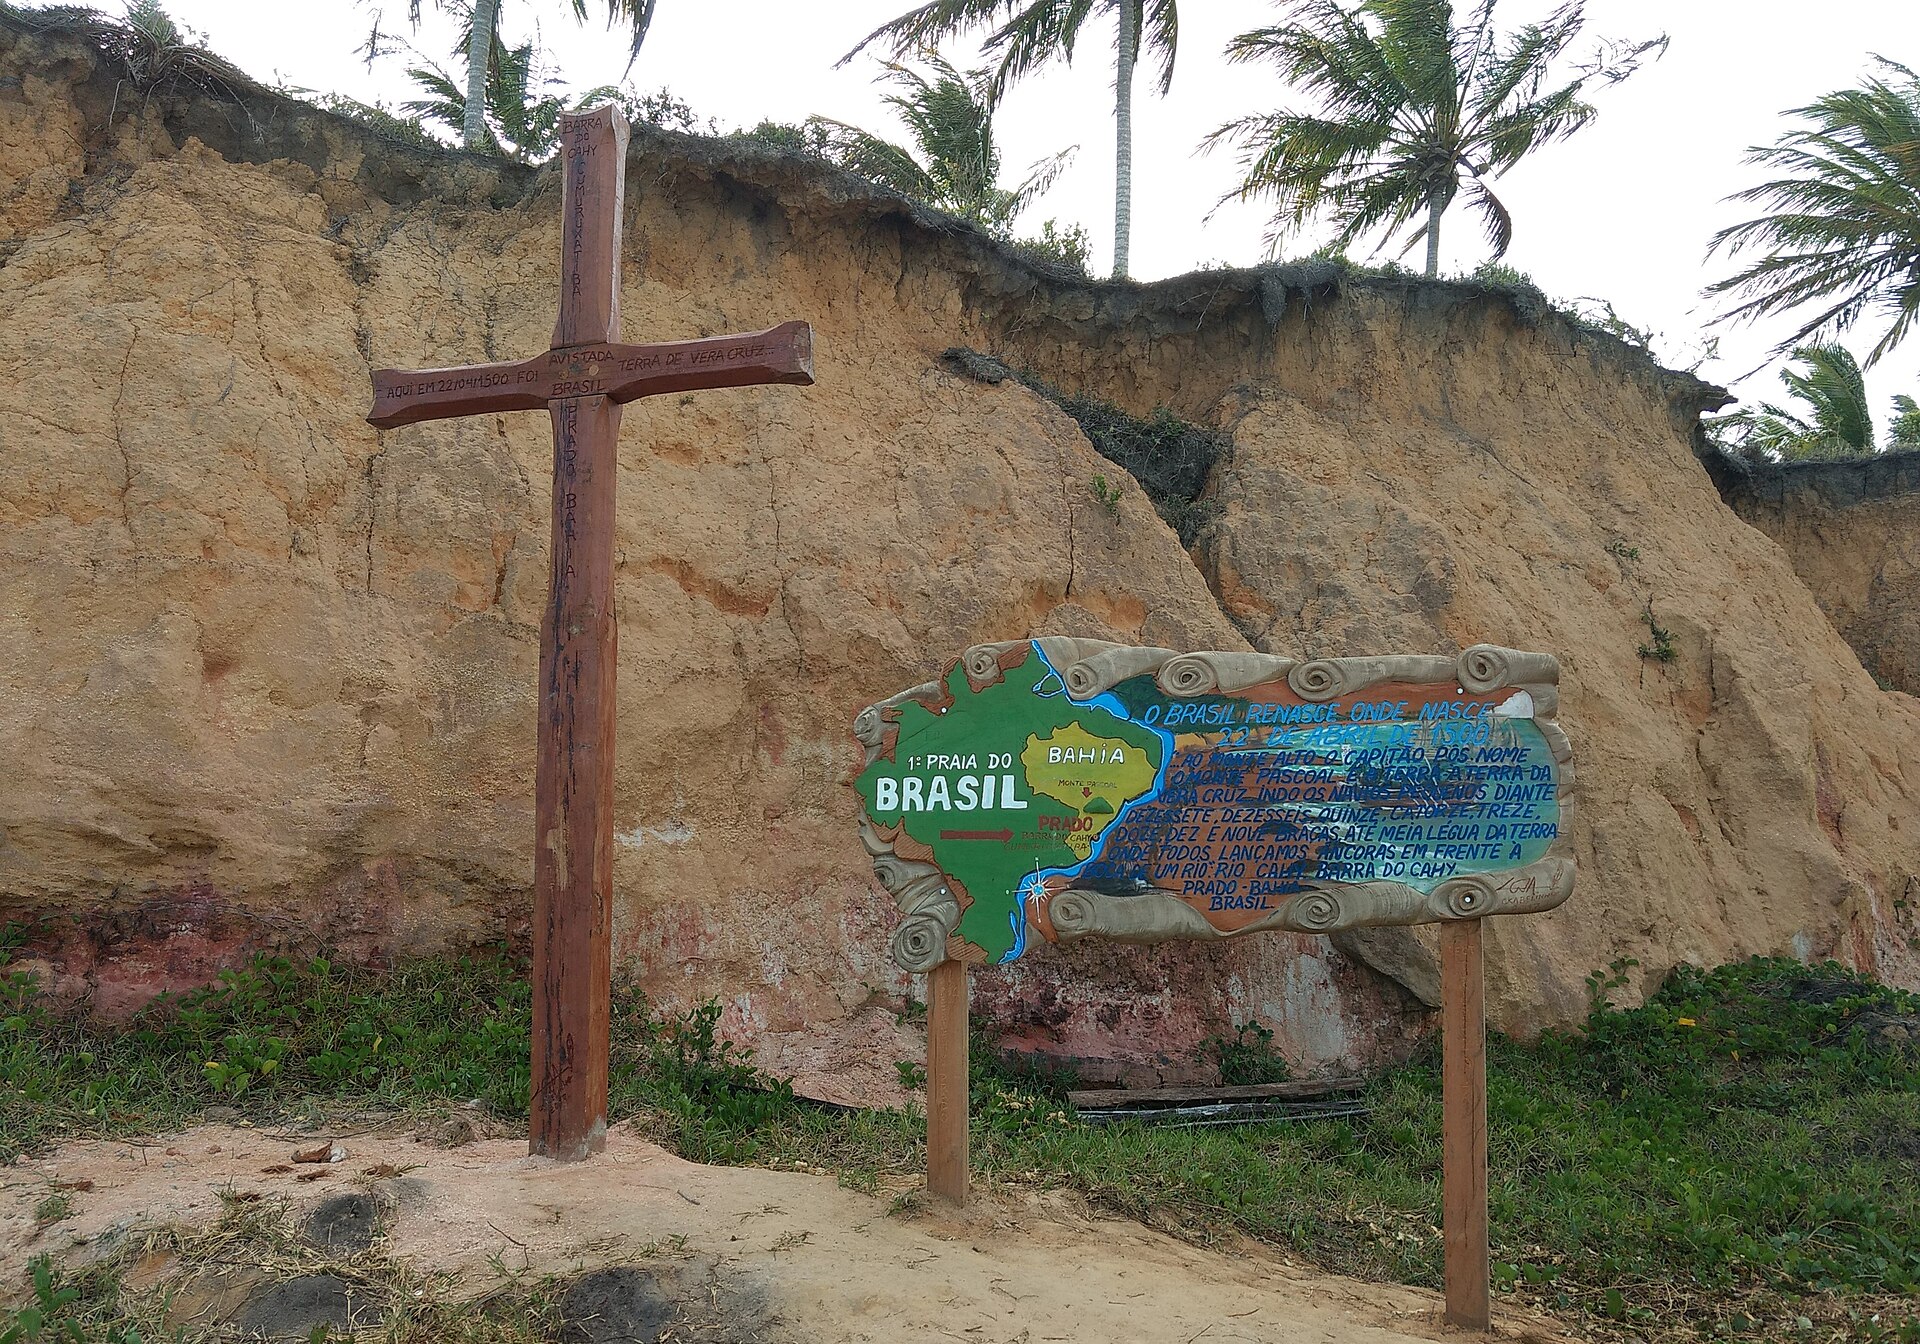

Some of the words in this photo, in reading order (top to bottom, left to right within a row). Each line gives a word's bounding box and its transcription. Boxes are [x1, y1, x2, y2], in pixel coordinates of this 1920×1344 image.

[562, 117, 603, 135] BARRA
[574, 132, 590, 144] DO
[567, 144, 598, 158] CAHY
[417, 381, 435, 396] EM
[516, 370, 539, 385] FOI
[549, 350, 615, 368] AVISTADA
[618, 356, 662, 372] TERRA
[665, 353, 683, 367] DE
[690, 349, 725, 365] VERA
[551, 379, 607, 397] BRASIL
[1144, 704, 1160, 725] O
[1164, 703, 1237, 725] BRASIL
[1245, 702, 1341, 725] RENASCE
[1350, 701, 1409, 721] ONDE
[1418, 700, 1495, 721] NASCE
[1217, 726, 1250, 747] 22
[1267, 725, 1296, 747] DE
[1304, 724, 1383, 747] ABRIL
[1388, 723, 1422, 746] DE
[926, 753, 978, 770] PRAIA
[988, 752, 1012, 769] DO
[1272, 749, 1317, 767] ALTO
[1323, 749, 1339, 766] O
[1475, 746, 1532, 763] NOME
[1256, 768, 1337, 785] PASCOAL
[1464, 764, 1524, 781] TERRA
[1529, 764, 1552, 781] DA
[876, 775, 1028, 812] BRASIL
[1302, 786, 1327, 801] OS
[1476, 802, 1541, 820] TREZE,
[1037, 815, 1094, 832] PRADO
[1166, 825, 1201, 842] DEZ
[1426, 819, 1480, 841] LÉGUA
[1485, 823, 1507, 841] DA
[1510, 822, 1557, 840] TERRA
[1107, 844, 1153, 861] ONDE
[1158, 844, 1212, 861] TODOS
[1218, 843, 1310, 863] LANÇAMOS
[1400, 843, 1428, 860] EM
[1433, 843, 1503, 860] FRENTE
[1154, 863, 1180, 879] UM
[1314, 860, 1376, 879] BARRA
[1382, 861, 1405, 878] DO
[1182, 879, 1238, 896] PRADO
